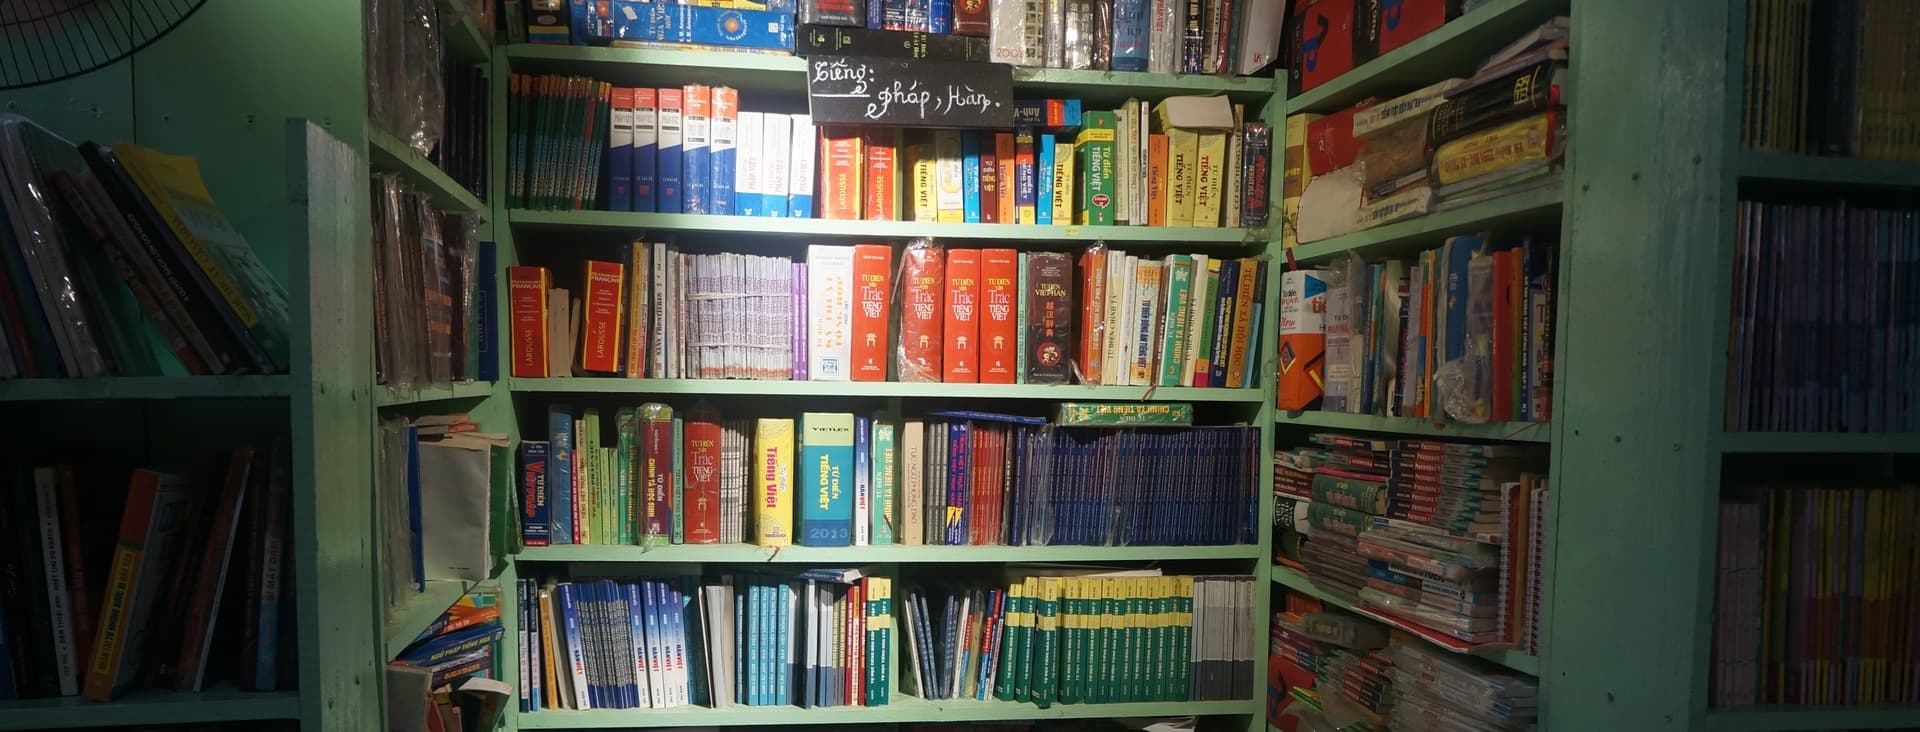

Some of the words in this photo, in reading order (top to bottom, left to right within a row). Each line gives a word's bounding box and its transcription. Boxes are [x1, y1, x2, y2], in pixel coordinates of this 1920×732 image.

[1092, 146, 1103, 171] TIẾNG
[1175, 154, 1187, 181] TIẾNG
[1199, 155, 1211, 183] TIẾNG
[838, 172, 848, 211] LAROUSSE
[875, 175, 885, 213] LAROUSSE
[1090, 172, 1102, 192] VIỆT
[525, 328, 534, 367] LAROUSSE
[596, 320, 607, 359] LAROUSSE
[766, 446, 778, 481] Tiếng
[819, 454, 832, 486] TIẾNG
[831, 465, 841, 477] TỪ
[765, 483, 778, 509] Việt
[817, 486, 829, 511] VIỆT
[831, 478, 842, 500] ĐIỂN
[810, 527, 849, 539] 2013
